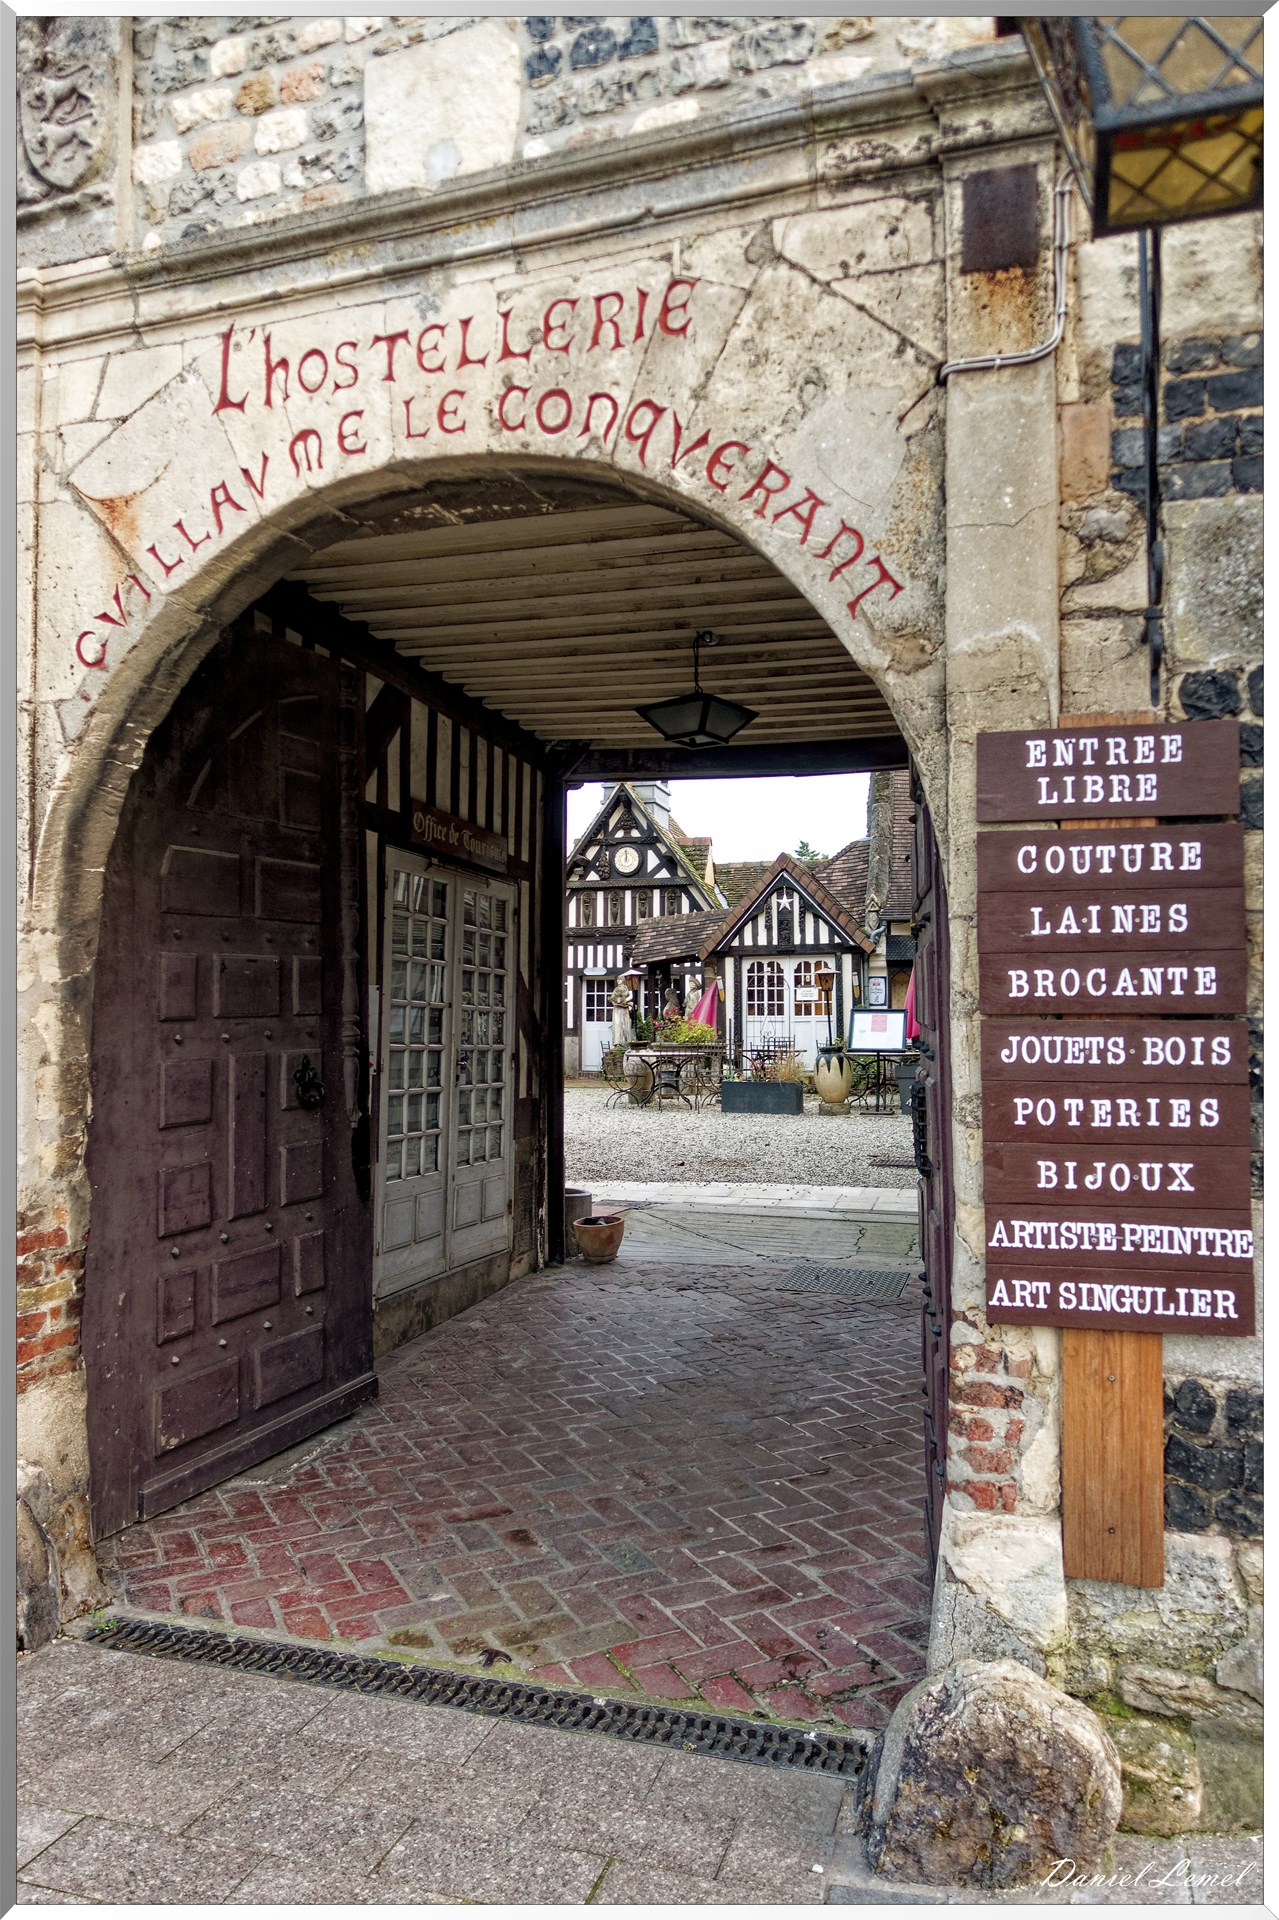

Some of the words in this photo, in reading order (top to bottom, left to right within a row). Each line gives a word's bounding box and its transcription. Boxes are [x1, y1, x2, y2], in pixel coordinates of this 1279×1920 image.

[403, 389, 466, 439] LE
[1025, 734, 1183, 768] ENTREE
[1037, 773, 1157, 805] LIBRE
[413, 811, 447, 842] Office
[449, 822, 459, 846] de
[1017, 841, 1202, 875] COUTURE
[1030, 903, 1188, 936] LAINES
[1007, 966, 1217, 998] BROCANTE
[1000, 1035, 1126, 1065] JOUETS
[1142, 1036, 1231, 1066] BOIS
[1013, 1097, 1220, 1128] POTERIES
[1036, 1160, 1195, 1192] BIJOUX
[987, 1219, 1118, 1251] ARTISTE
[1120, 1223, 1254, 1259] PEINTRE
[988, 1278, 1051, 1309] ART
[1058, 1281, 1239, 1319] SINGULIER
